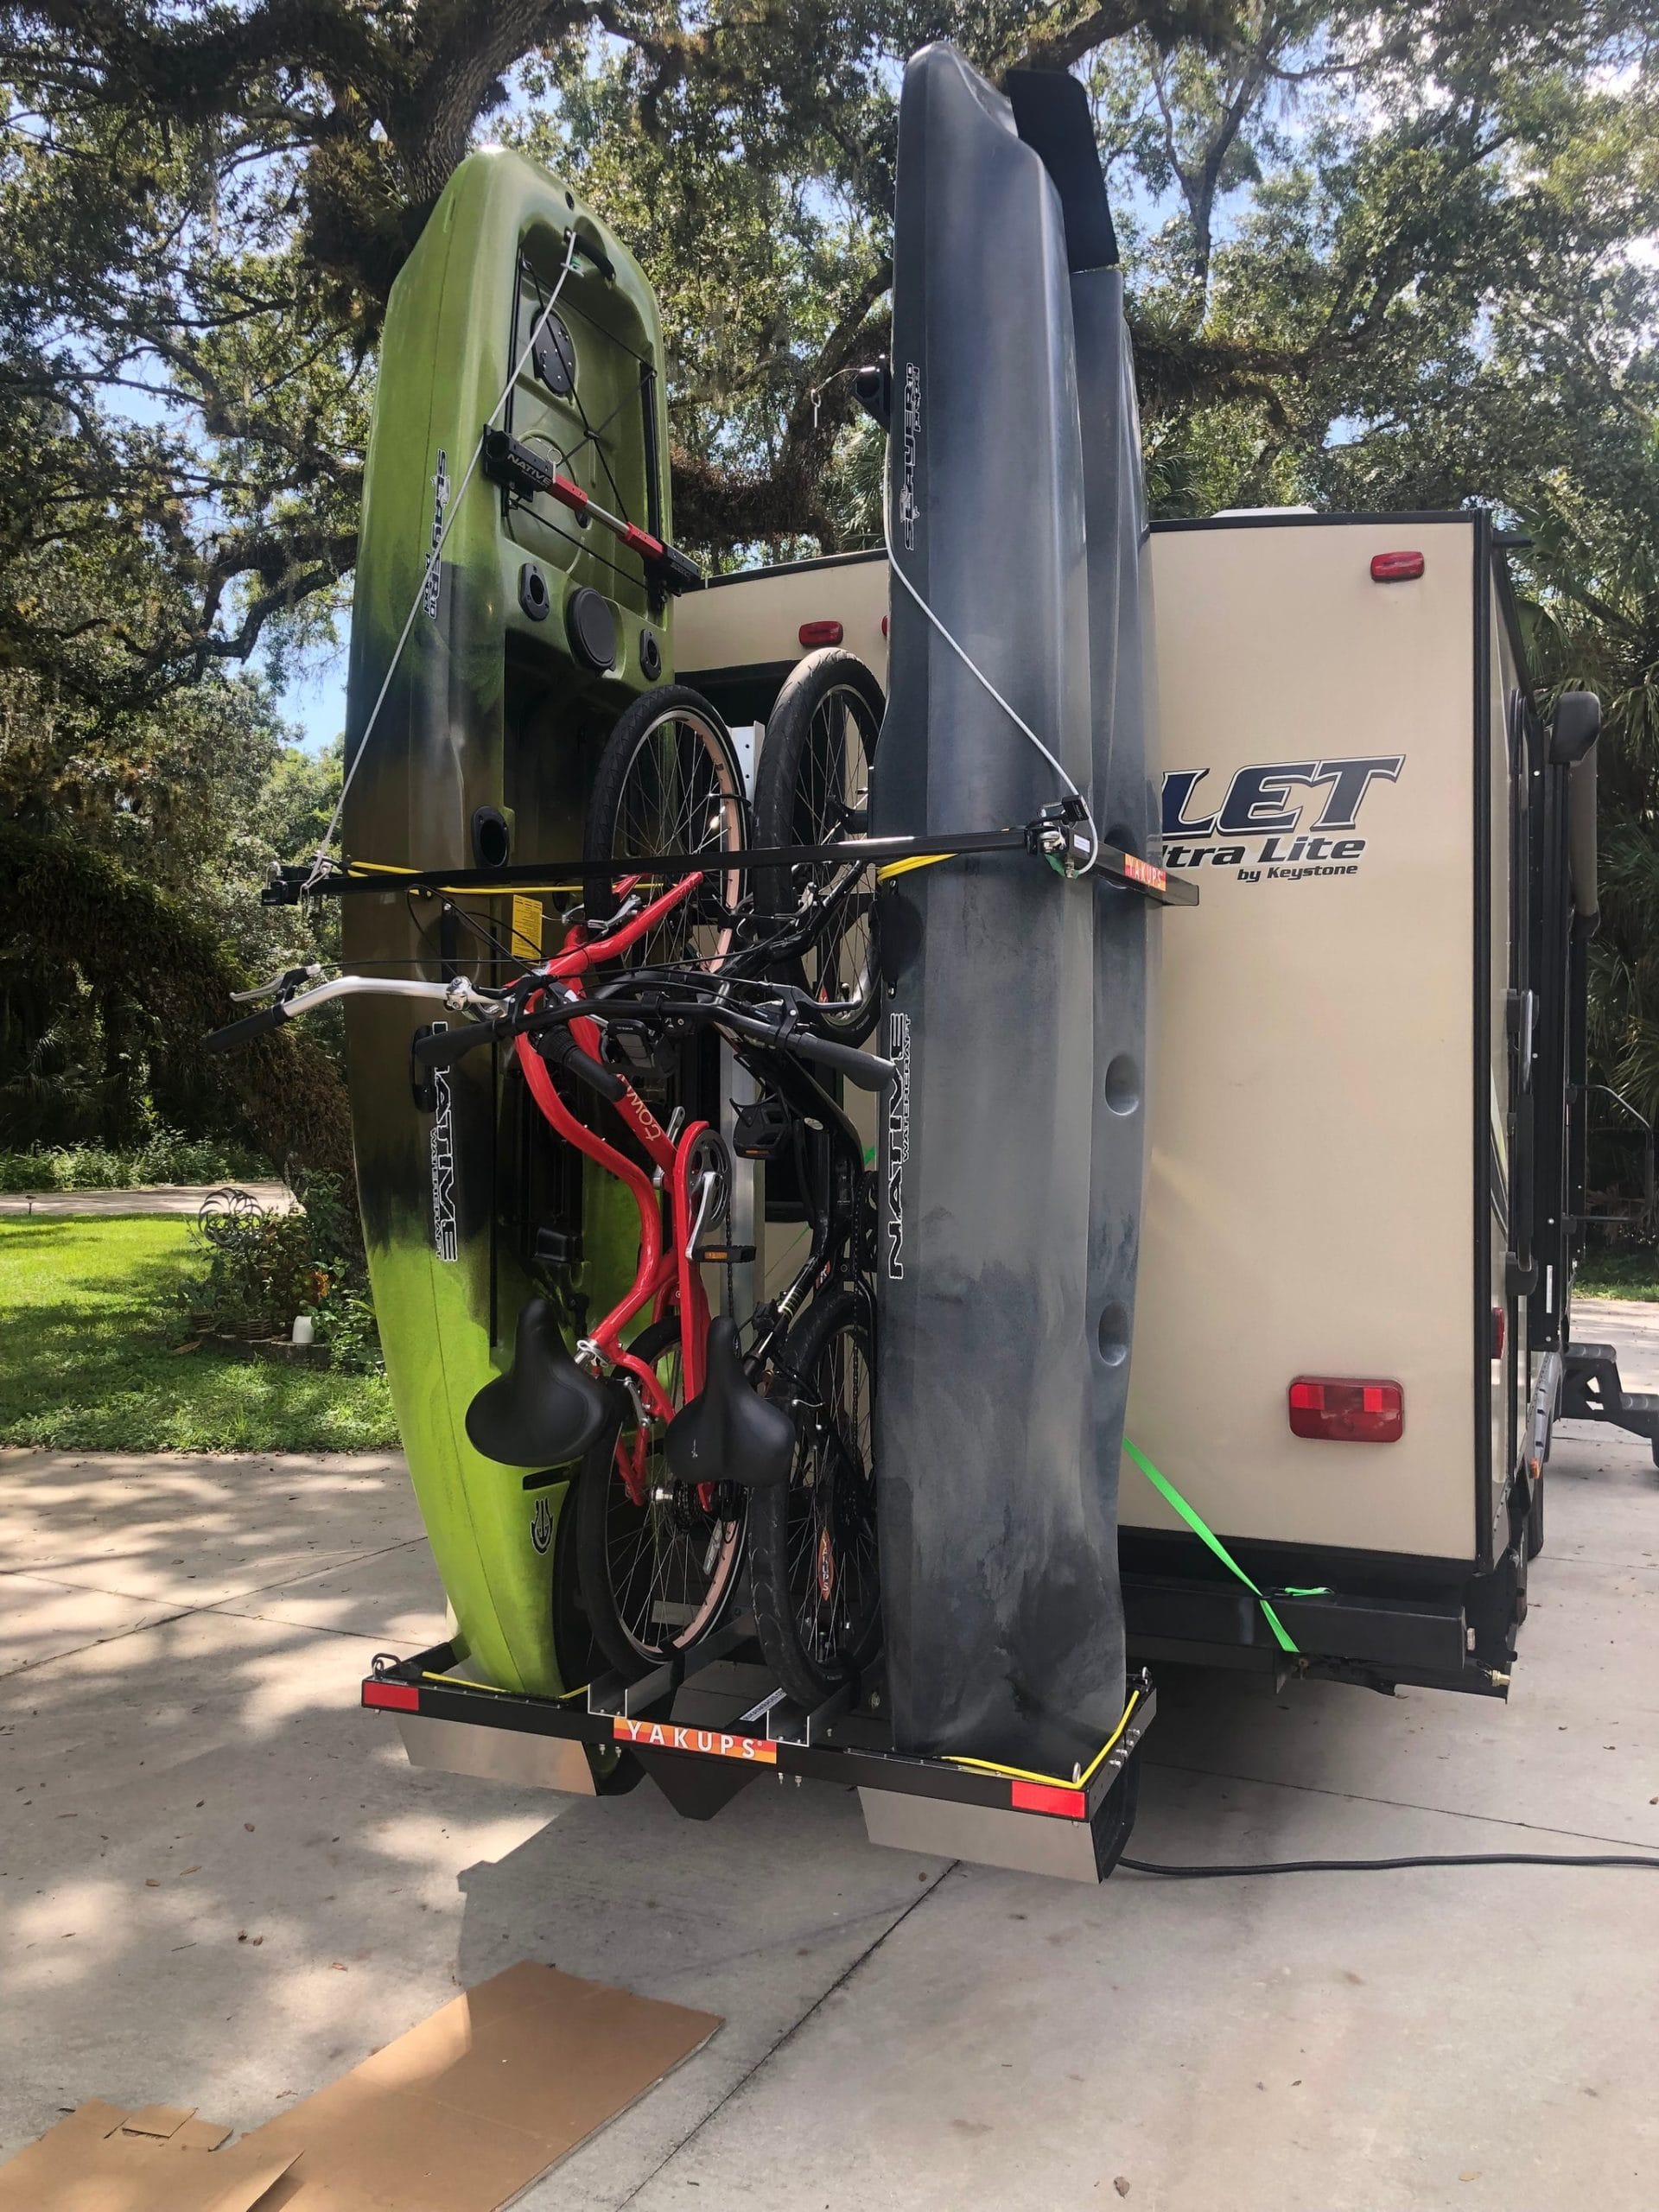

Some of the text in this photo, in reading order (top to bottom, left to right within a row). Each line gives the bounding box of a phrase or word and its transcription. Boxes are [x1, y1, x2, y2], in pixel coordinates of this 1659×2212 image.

[507, 454, 553, 486] NATIVE
[905, 385, 915, 551] SLAYER
[1257, 836, 1366, 862] Lite
[1128, 856, 1161, 887] YAKUPS
[1237, 866, 1358, 882] by Keystone
[902, 1014, 911, 1162] WATERCRAFT
[888, 1013, 904, 1280] NATIVE
[430, 1128, 442, 1260] WATERCRAFT
[626, 1720, 756, 1759] YAKUPS
